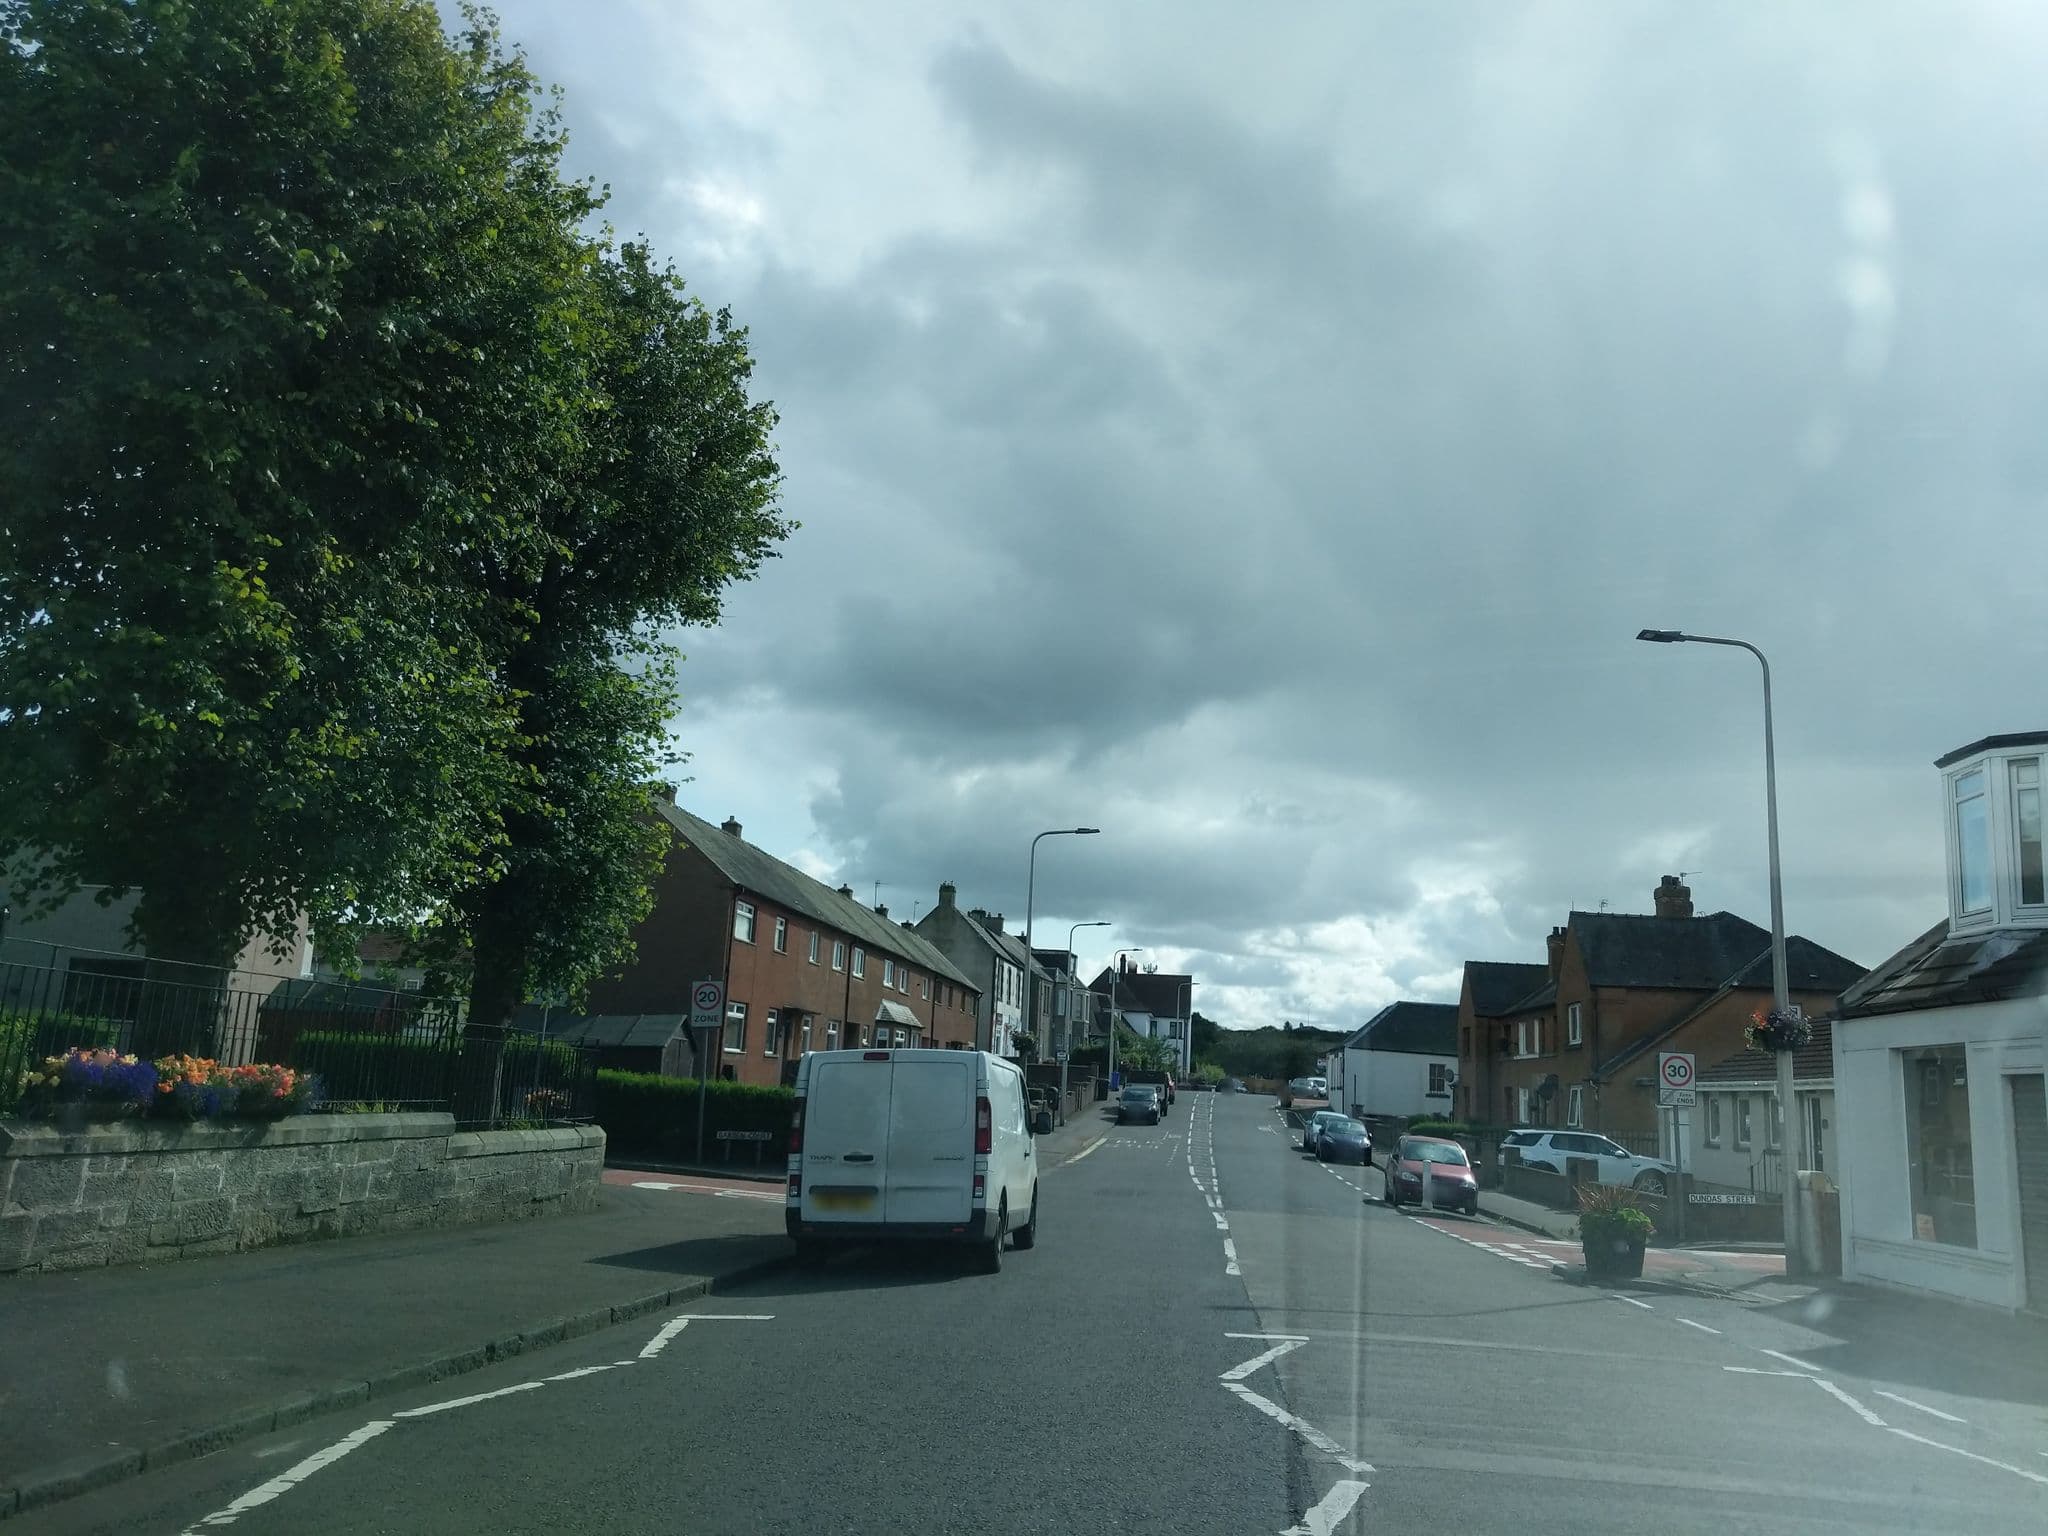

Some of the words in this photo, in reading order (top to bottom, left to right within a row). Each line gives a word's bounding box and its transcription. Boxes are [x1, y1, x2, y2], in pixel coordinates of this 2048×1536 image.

[699, 991, 716, 1002] 20
[1667, 1065, 1687, 1077] 30
[1690, 1194, 1722, 1203] DUNDAS
[1726, 1195, 1754, 1203] STREET
